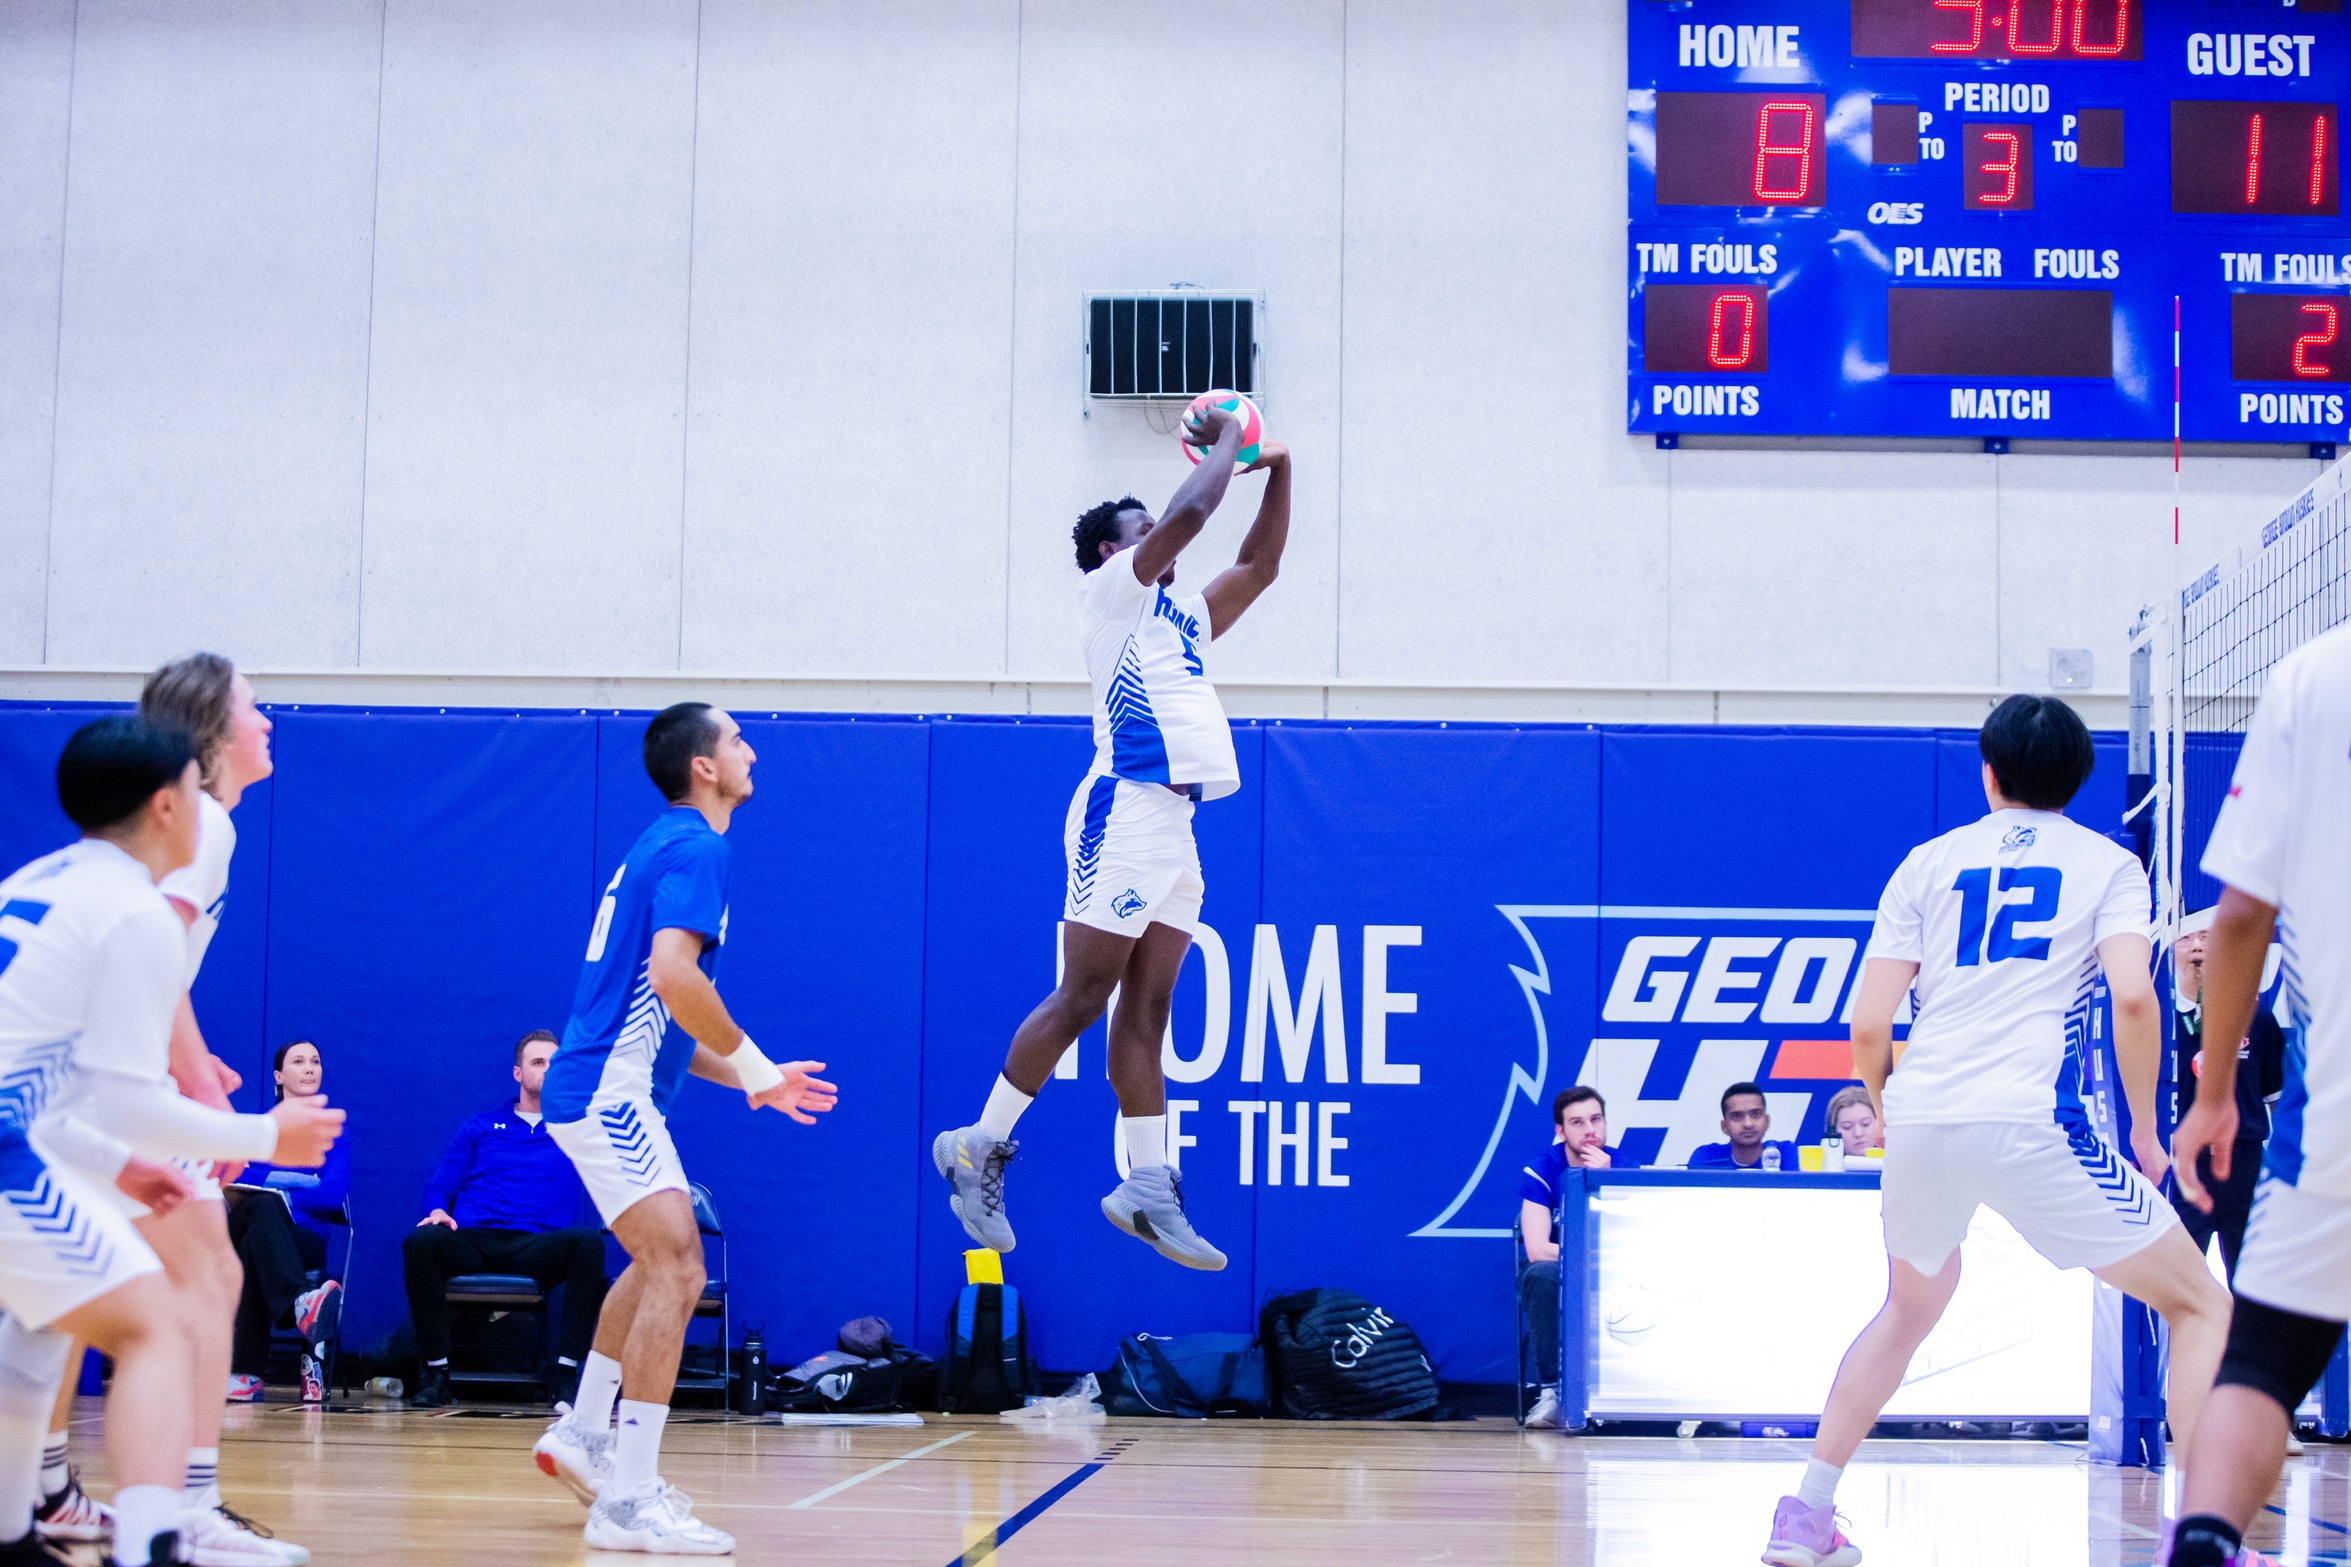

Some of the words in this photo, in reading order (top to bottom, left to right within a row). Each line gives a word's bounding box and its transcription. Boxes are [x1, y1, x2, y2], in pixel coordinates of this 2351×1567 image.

[1679, 25, 1800, 68] HOME
[2186, 32, 2316, 77] GUEST
[1945, 82, 2050, 113] PERIOD
[1918, 111, 1933, 133] P
[2062, 115, 2077, 136] P
[1754, 101, 1814, 201] 8
[1921, 138, 1945, 160] TO
[2052, 140, 2078, 163] TO
[2245, 113, 2326, 205] 11
[1978, 132, 2018, 203] 3
[1867, 202, 1924, 225] OES
[1636, 243, 1679, 273] TM
[1690, 244, 1778, 274] FOULS
[1894, 247, 2002, 278] PLAYER
[2033, 249, 2120, 279] FOULS
[2220, 252, 2263, 282] TM
[2274, 253, 2351, 285] FOULS
[1710, 294, 1754, 367] 0
[2294, 303, 2337, 376] 2
[1652, 385, 1760, 416] POINTS
[1950, 388, 2051, 420] MATCH
[2240, 393, 2344, 424] POINTS
[1951, 865, 2063, 968] 12
[1054, 920, 1422, 1084] OME
[1228, 1100, 1351, 1187] THE
